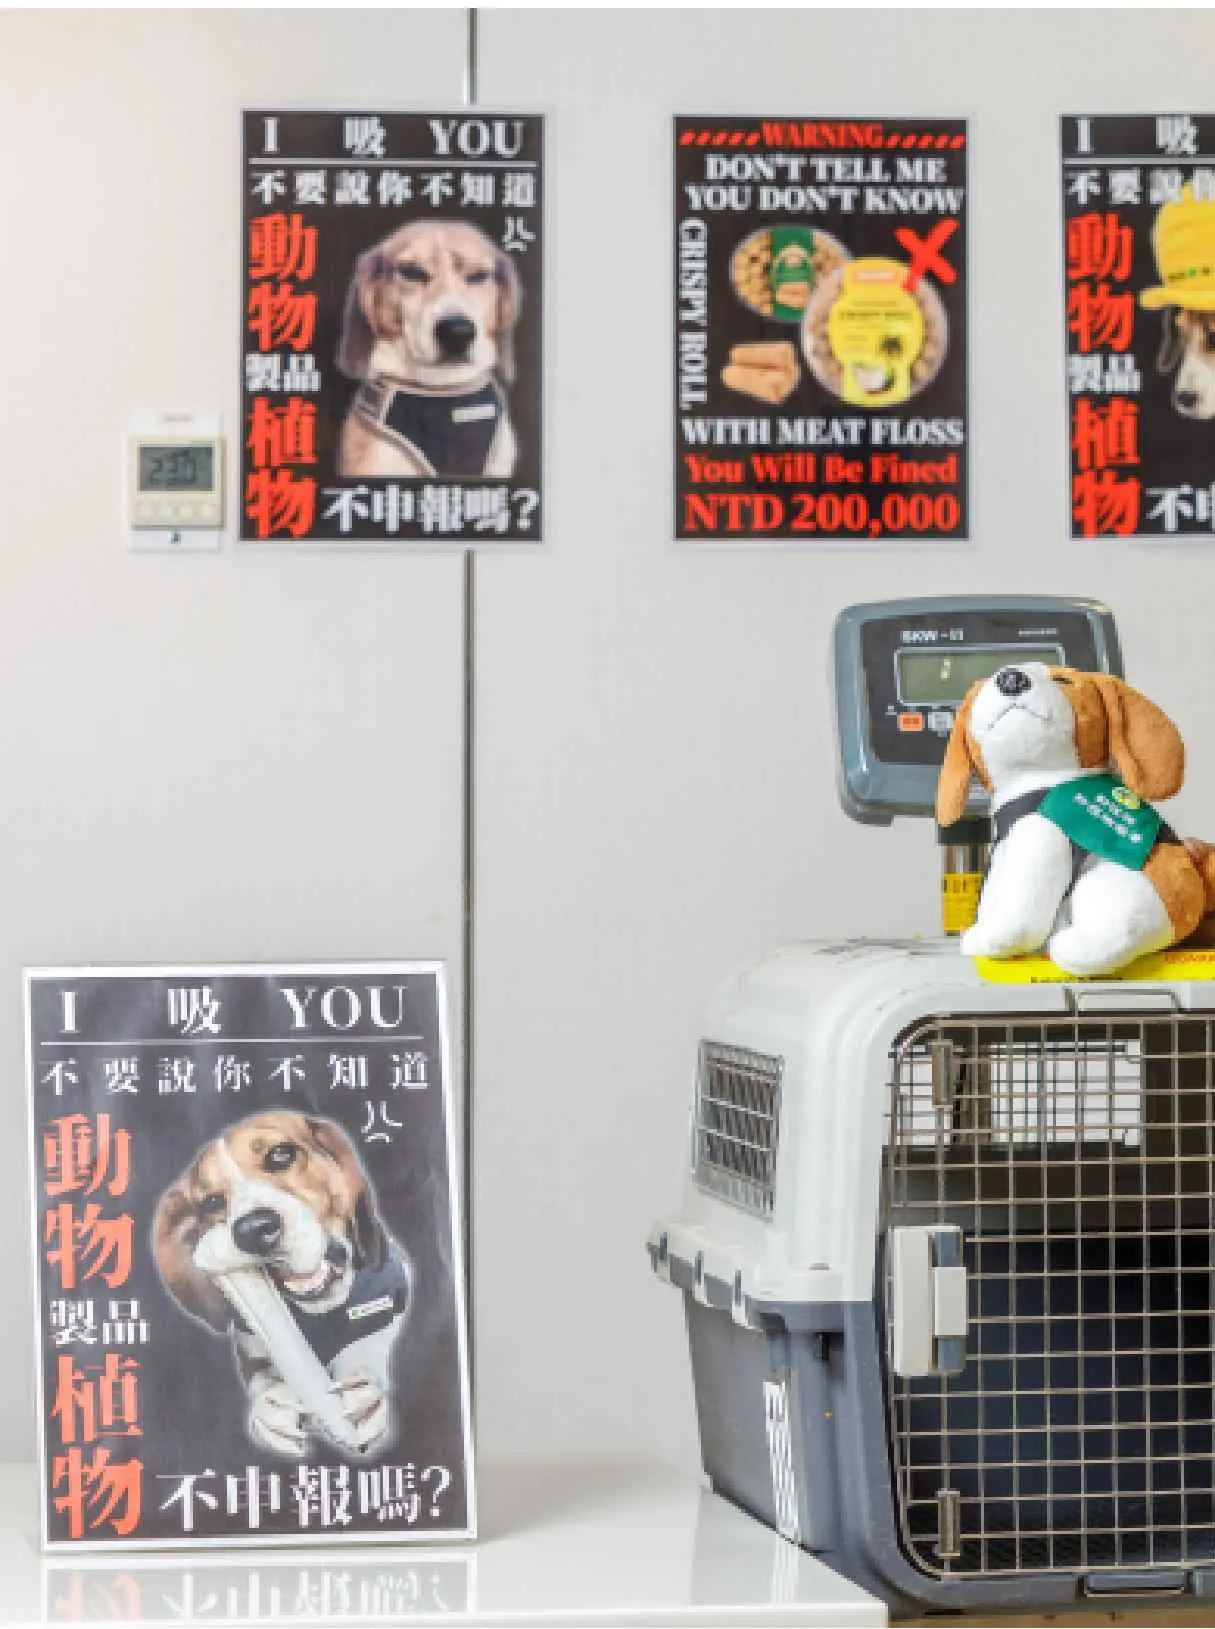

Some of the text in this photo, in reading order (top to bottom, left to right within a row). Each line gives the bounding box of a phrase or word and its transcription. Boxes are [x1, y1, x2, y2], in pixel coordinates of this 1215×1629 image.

[428, 118, 526, 158] YOU
[762, 121, 884, 148] WARNING
[704, 153, 948, 183] DON'T TELL ME
[684, 183, 965, 213] YOU DON'T KNOW
[679, 217, 709, 410] CRISPY ROLL
[682, 415, 965, 446] WITH MEAT FLOSS
[683, 451, 960, 484] You Will Be Fined
[683, 491, 962, 539] NTD 200,000
[57, 984, 406, 1036] I 吸 YOU
[41, 1052, 432, 1096] 不要說你不知道
[48, 1298, 150, 1346] 製品
[154, 1462, 452, 1533] 不申報嗎?
